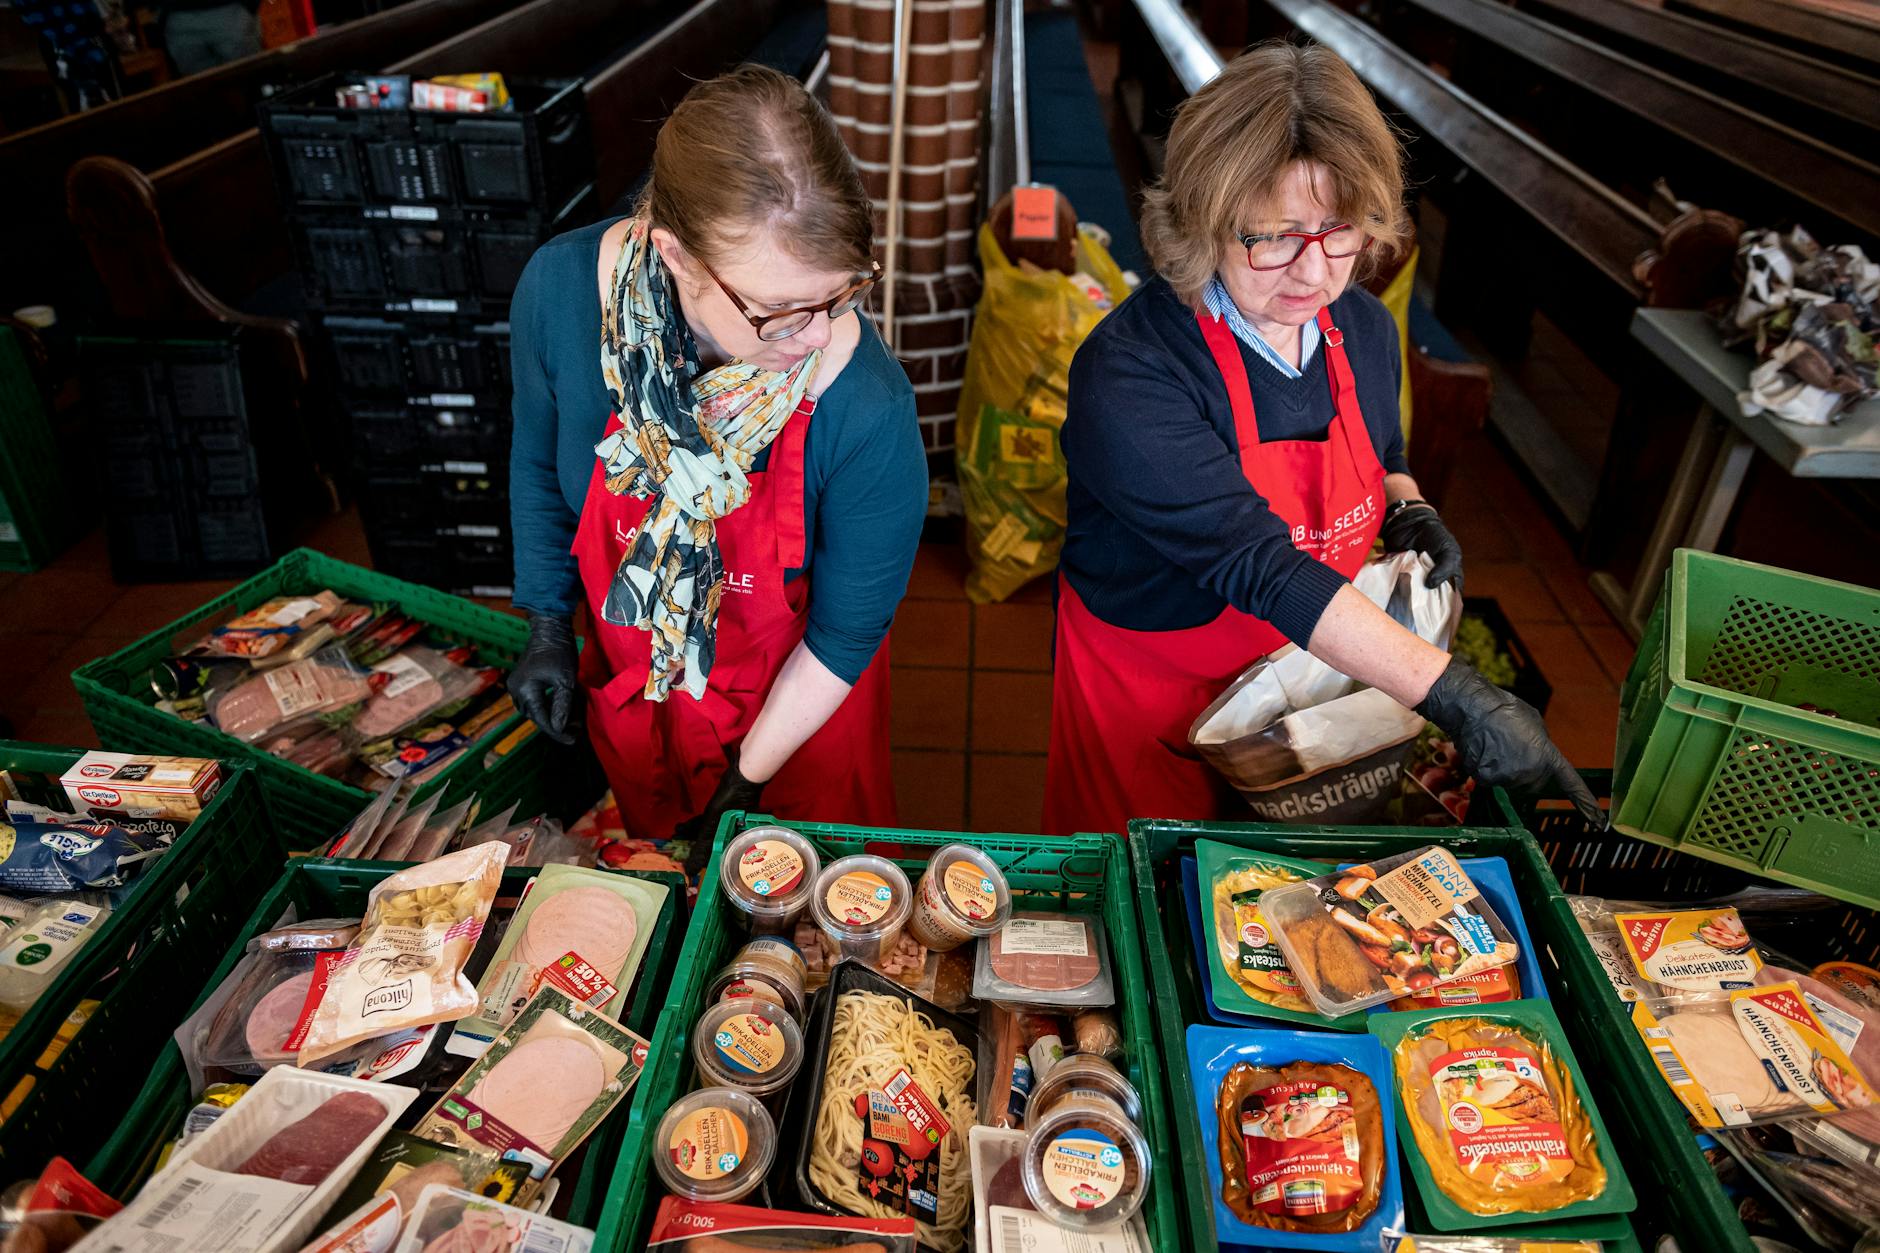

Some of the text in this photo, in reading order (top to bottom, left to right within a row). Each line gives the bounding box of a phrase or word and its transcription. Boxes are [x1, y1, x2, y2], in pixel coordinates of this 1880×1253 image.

[1310, 528, 1333, 541] UND
[91, 791, 118, 800] Oetker
[745, 855, 790, 881] FRIKADELLEN
[1410, 863, 1432, 883] MINI
[1420, 858, 1464, 899] READY
[952, 880, 995, 905] FRIKADELLEN
[1401, 868, 1444, 912] SCHNITZEL
[837, 889, 885, 911] FRIKADELLEN
[1630, 921, 1645, 938] GUT
[1640, 930, 1648, 938] &
[1665, 951, 1717, 964] Delikatess
[573, 961, 607, 991] 30%
[1491, 972, 1501, 982] 2
[1659, 959, 1749, 978] HÄHNCHENBRUST
[565, 971, 593, 997] billiger.
[366, 988, 409, 1009] hilcona
[1776, 993, 1800, 1009] GUT
[1782, 1000, 1792, 1010] &
[728, 1022, 772, 1059] FRIKADELLEN
[1462, 1047, 1498, 1059] Paprika
[1741, 1006, 1817, 1097] HÄHNCHENBRUST
[1269, 1081, 1318, 1096] BARBECUE
[897, 1094, 926, 1132] 30%
[904, 1089, 932, 1123] billiger.
[872, 1110, 891, 1123] BAMI
[872, 1121, 908, 1140] GORENG
[702, 1118, 713, 1175] FRIKADELLEN
[1459, 1139, 1567, 1158] Hähnchensteaks
[1054, 1161, 1119, 1182] FRIKADELLEN
[1344, 1165, 1354, 1177] 2
[692, 1213, 716, 1229] 500
